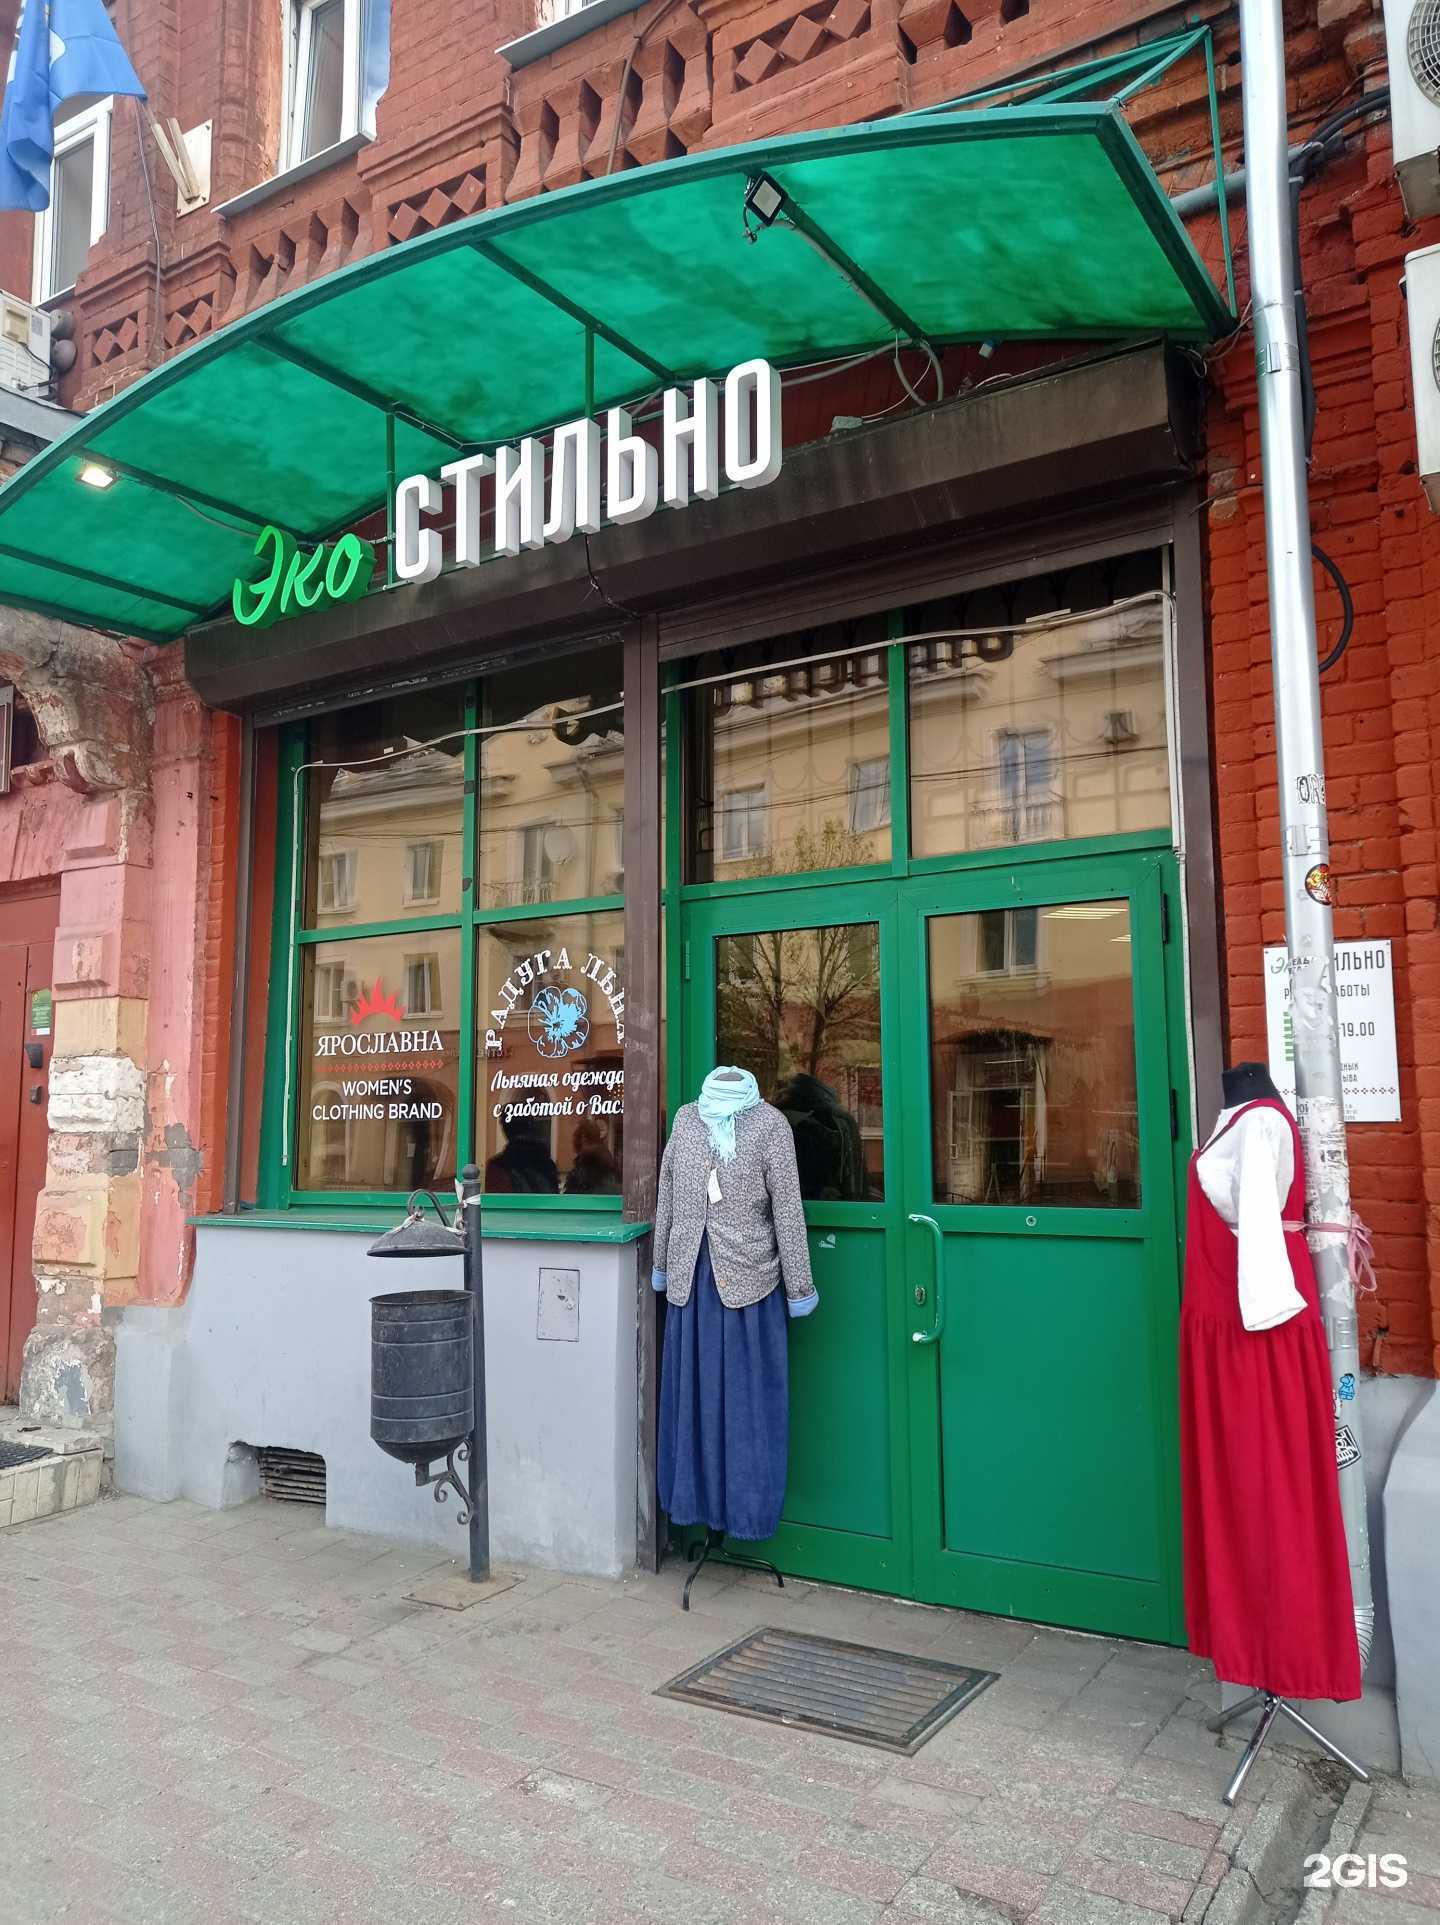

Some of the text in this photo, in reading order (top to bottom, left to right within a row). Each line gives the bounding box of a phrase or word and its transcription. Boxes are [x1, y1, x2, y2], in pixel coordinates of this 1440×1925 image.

[233, 358, 784, 630] Эко СТИЛЬНО
[485, 947, 573, 1051] РАДУГА
[314, 1030, 444, 1057] ЯРОСЛАВНА
[342, 1079, 412, 1096] WOMEN'S
[490, 1070, 624, 1093] Льняная одежда
[312, 1102, 443, 1120] CLOTHING BRAND
[493, 1103, 503, 1118] с
[504, 1096, 573, 1123] заботой
[576, 1102, 589, 1115] о
